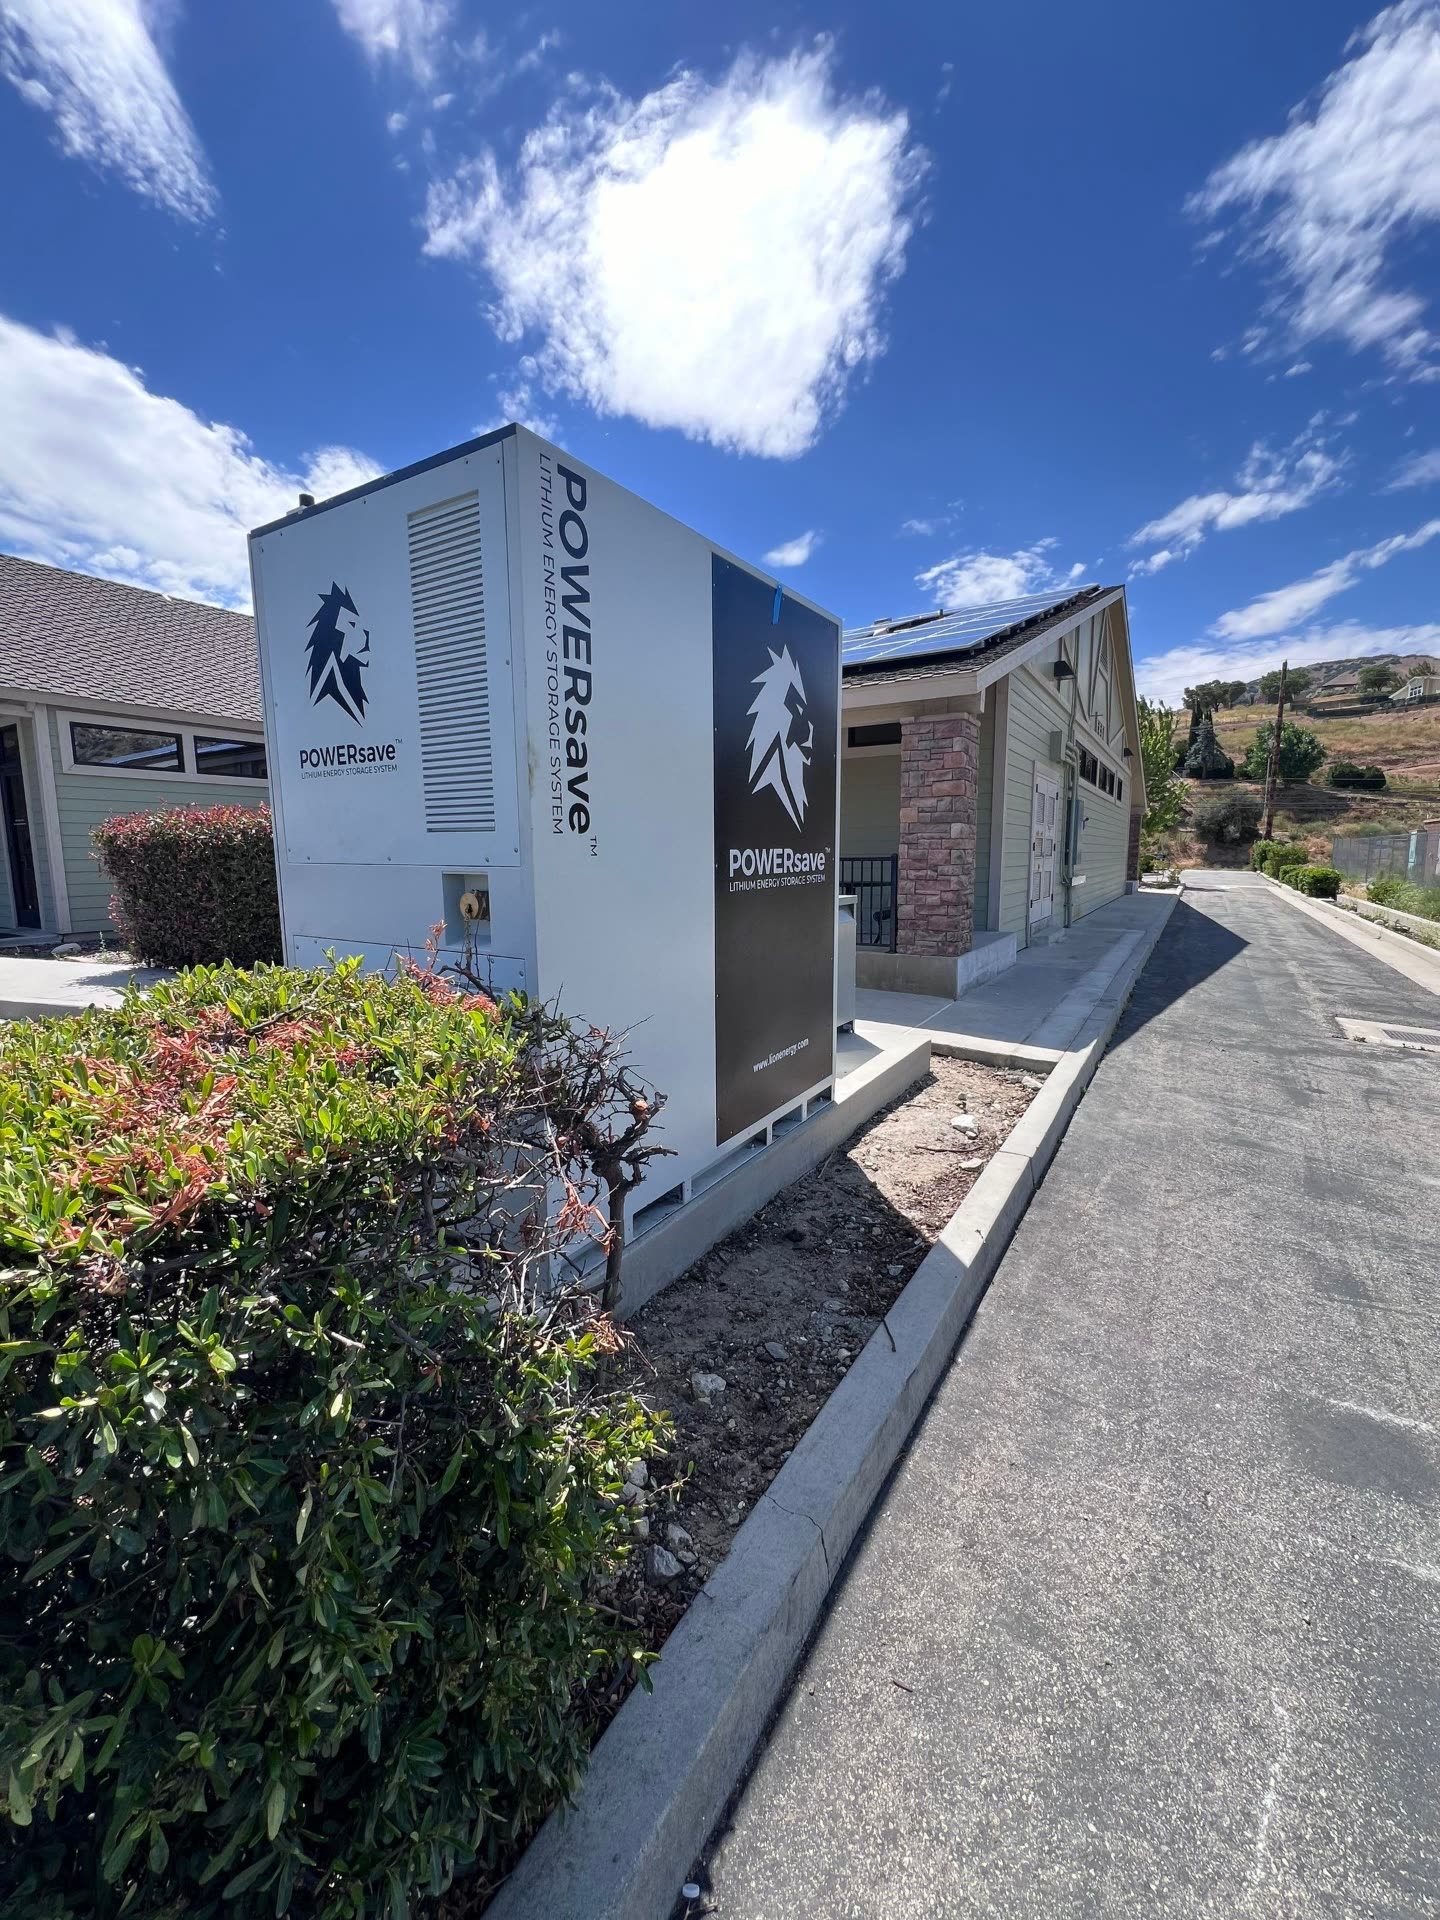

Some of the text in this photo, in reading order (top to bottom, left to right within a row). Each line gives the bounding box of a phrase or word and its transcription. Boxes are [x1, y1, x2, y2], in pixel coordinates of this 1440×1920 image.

[539, 452, 564, 834] LITHIUM ENERGY STORAGE SYSTEM
[301, 764, 397, 780] LITHIUM ENERGY STORAGE SYSTEM
[729, 874, 826, 892] LITHIUM ENERGY STORAGE SYSTEM
[752, 1038, 809, 1073] www.lionenergy.com
